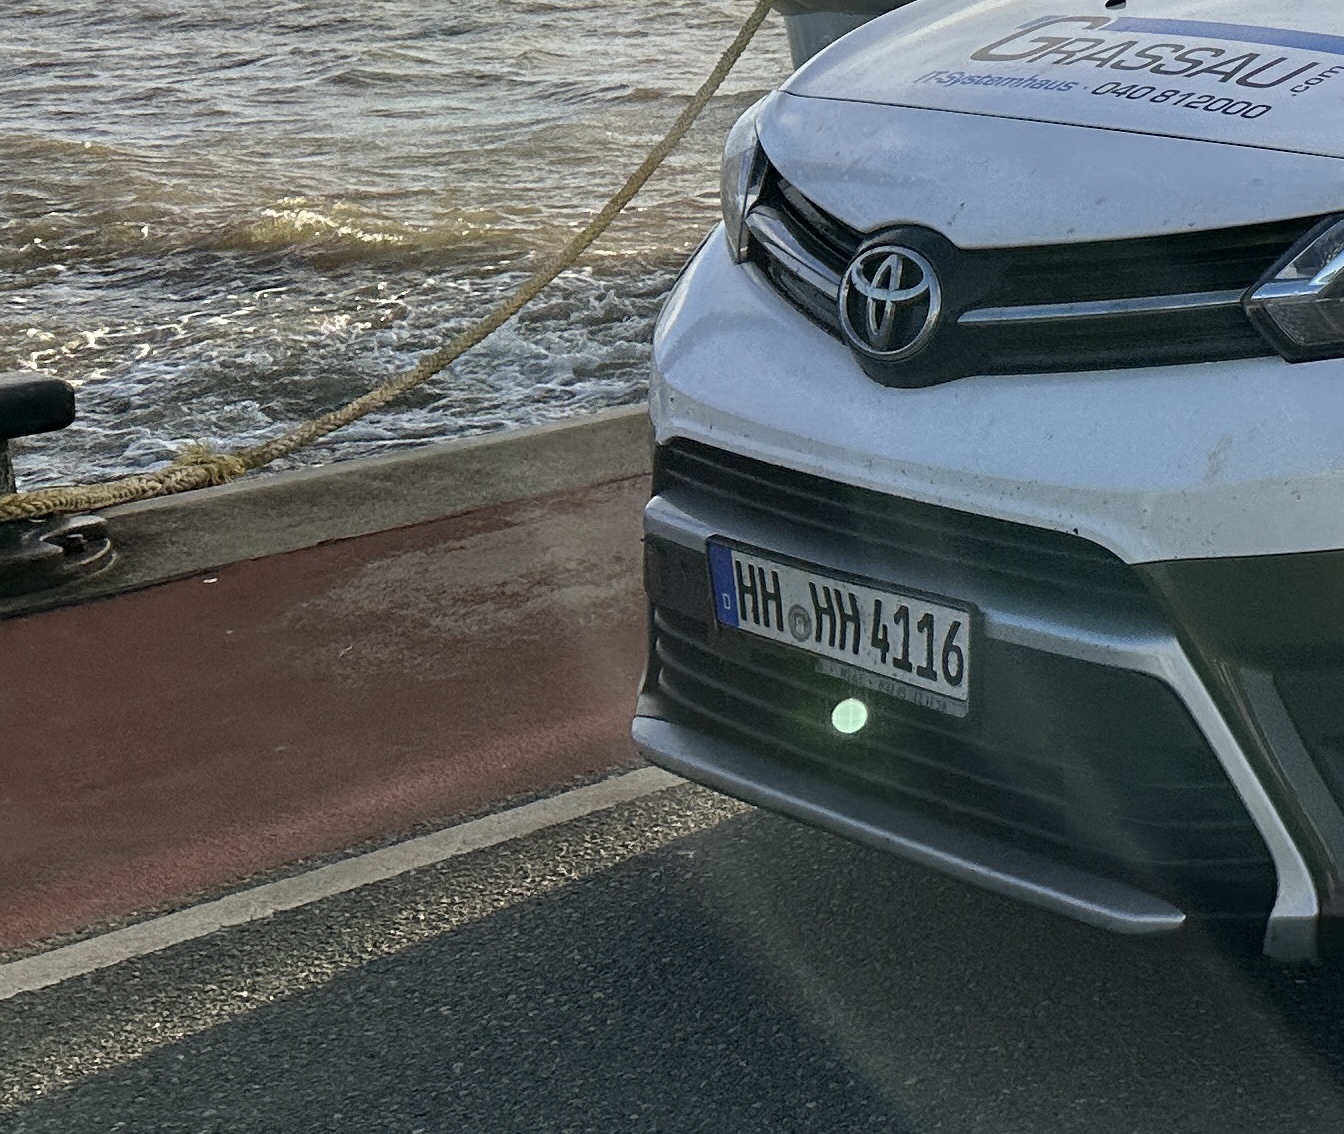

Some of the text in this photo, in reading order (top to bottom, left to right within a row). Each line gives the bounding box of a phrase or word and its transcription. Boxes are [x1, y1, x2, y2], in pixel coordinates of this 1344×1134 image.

[970, 15, 1327, 89] GRASSAU
[912, 69, 1274, 120] IT-Systemhaus 040 812000
[734, 560, 785, 633] HH
[808, 581, 862, 655] HH
[870, 598, 965, 688] 4116
